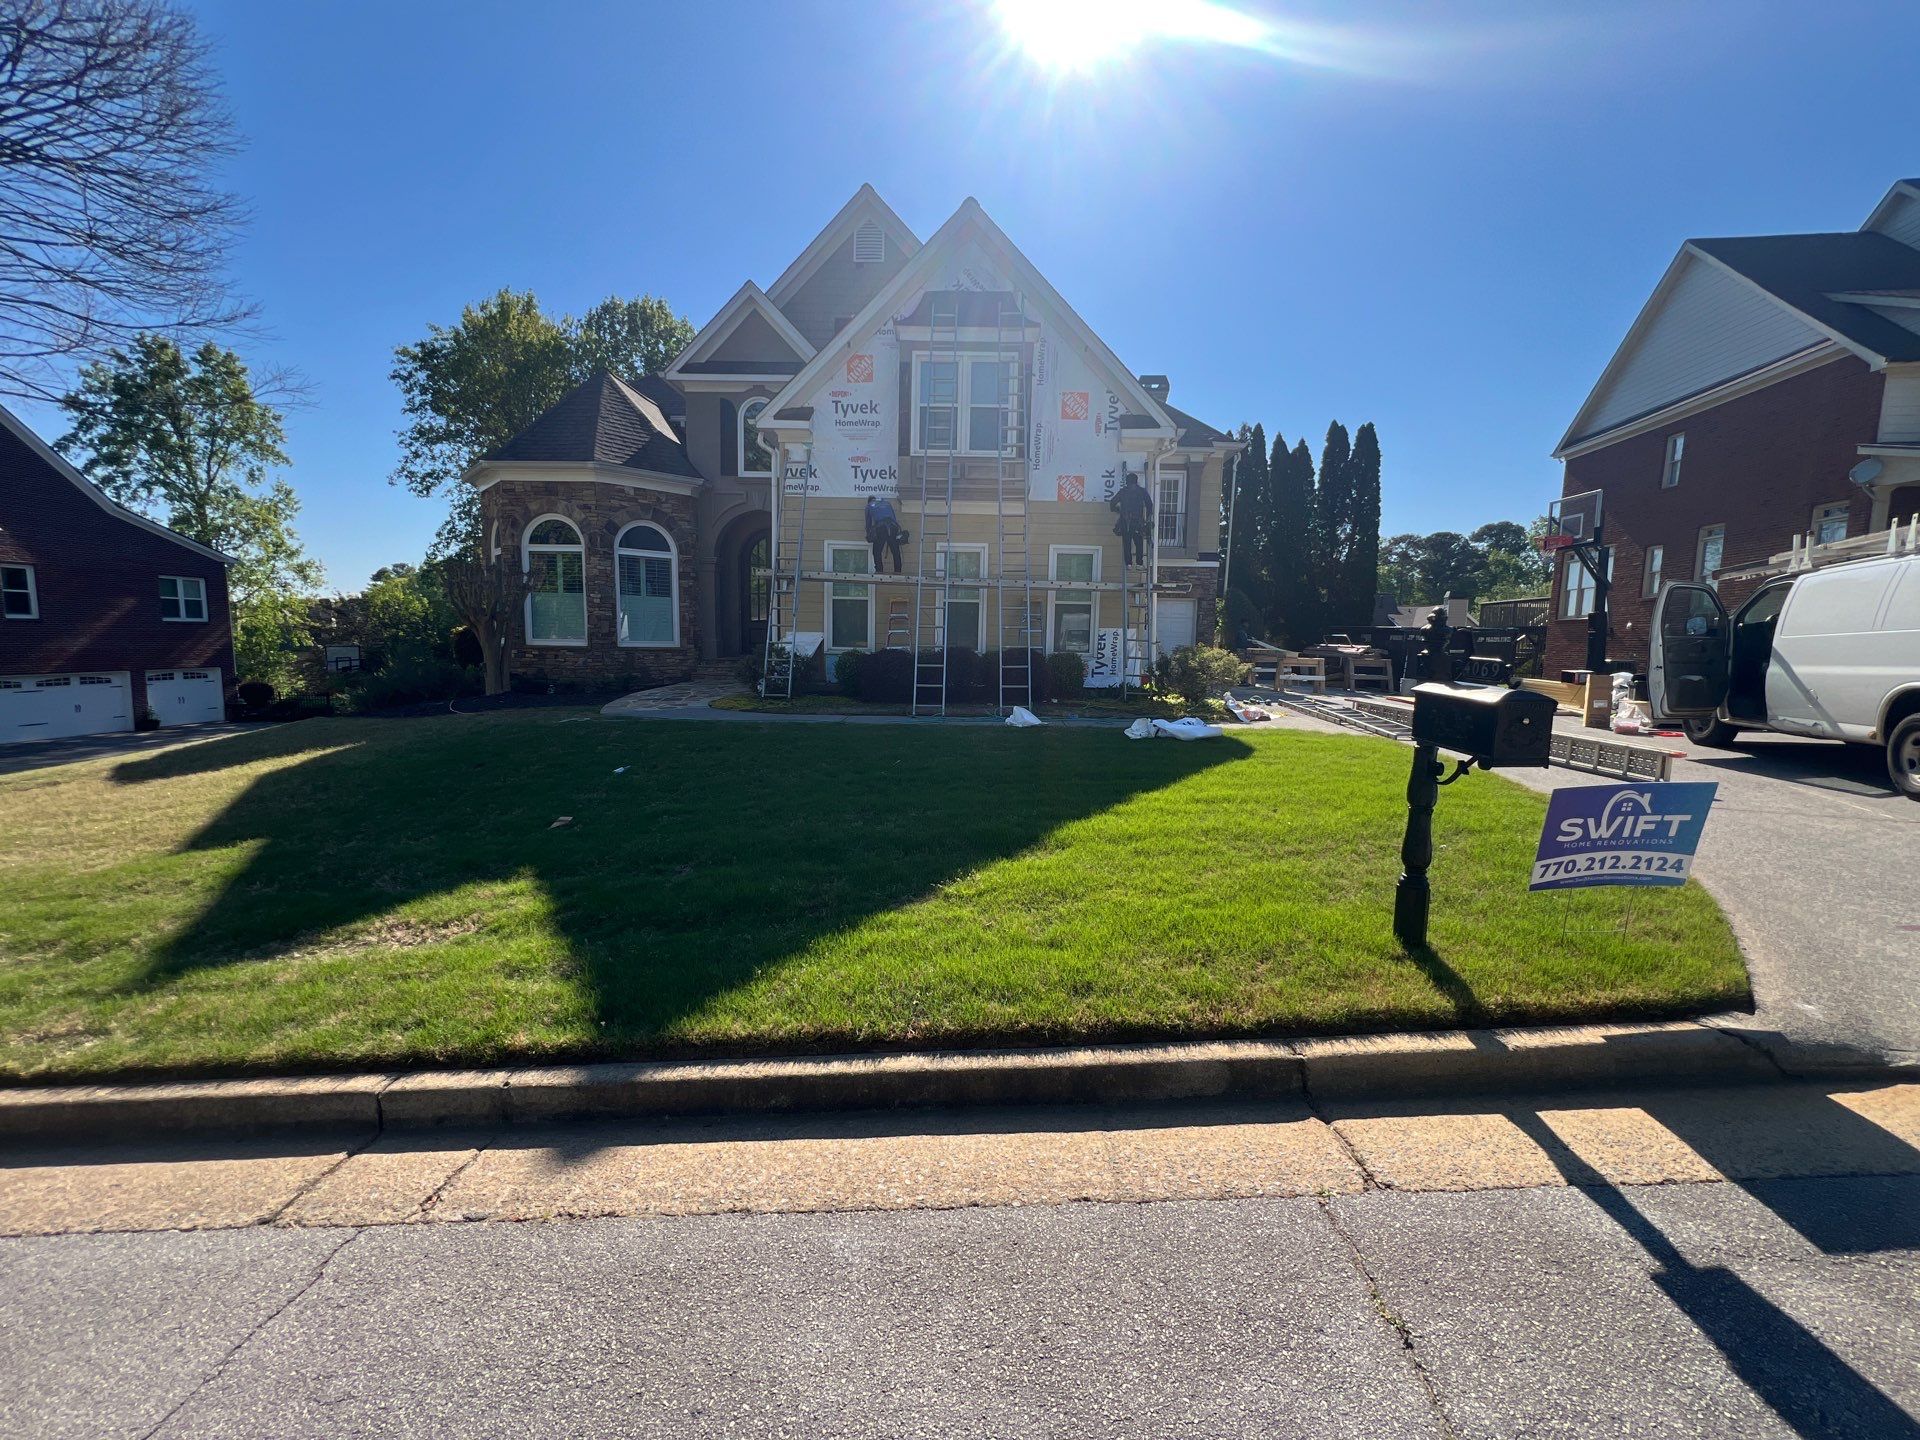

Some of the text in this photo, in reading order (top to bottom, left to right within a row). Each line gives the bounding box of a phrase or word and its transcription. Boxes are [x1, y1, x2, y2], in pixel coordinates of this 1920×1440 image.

[1036, 337, 1047, 386] HomeWrap
[831, 400, 879, 418] Tyvek
[834, 419, 881, 428] HomeWrap
[1033, 422, 1044, 471] HomeWrap
[850, 465, 898, 483] Tyvek
[1091, 633, 1109, 678] Tyvek
[1109, 631, 1120, 675] HomeWrap
[1556, 813, 1692, 842] SWIFT
[1564, 838, 1673, 848] HOME RENOVATIONS
[1538, 854, 1684, 879] 770.212.2124
